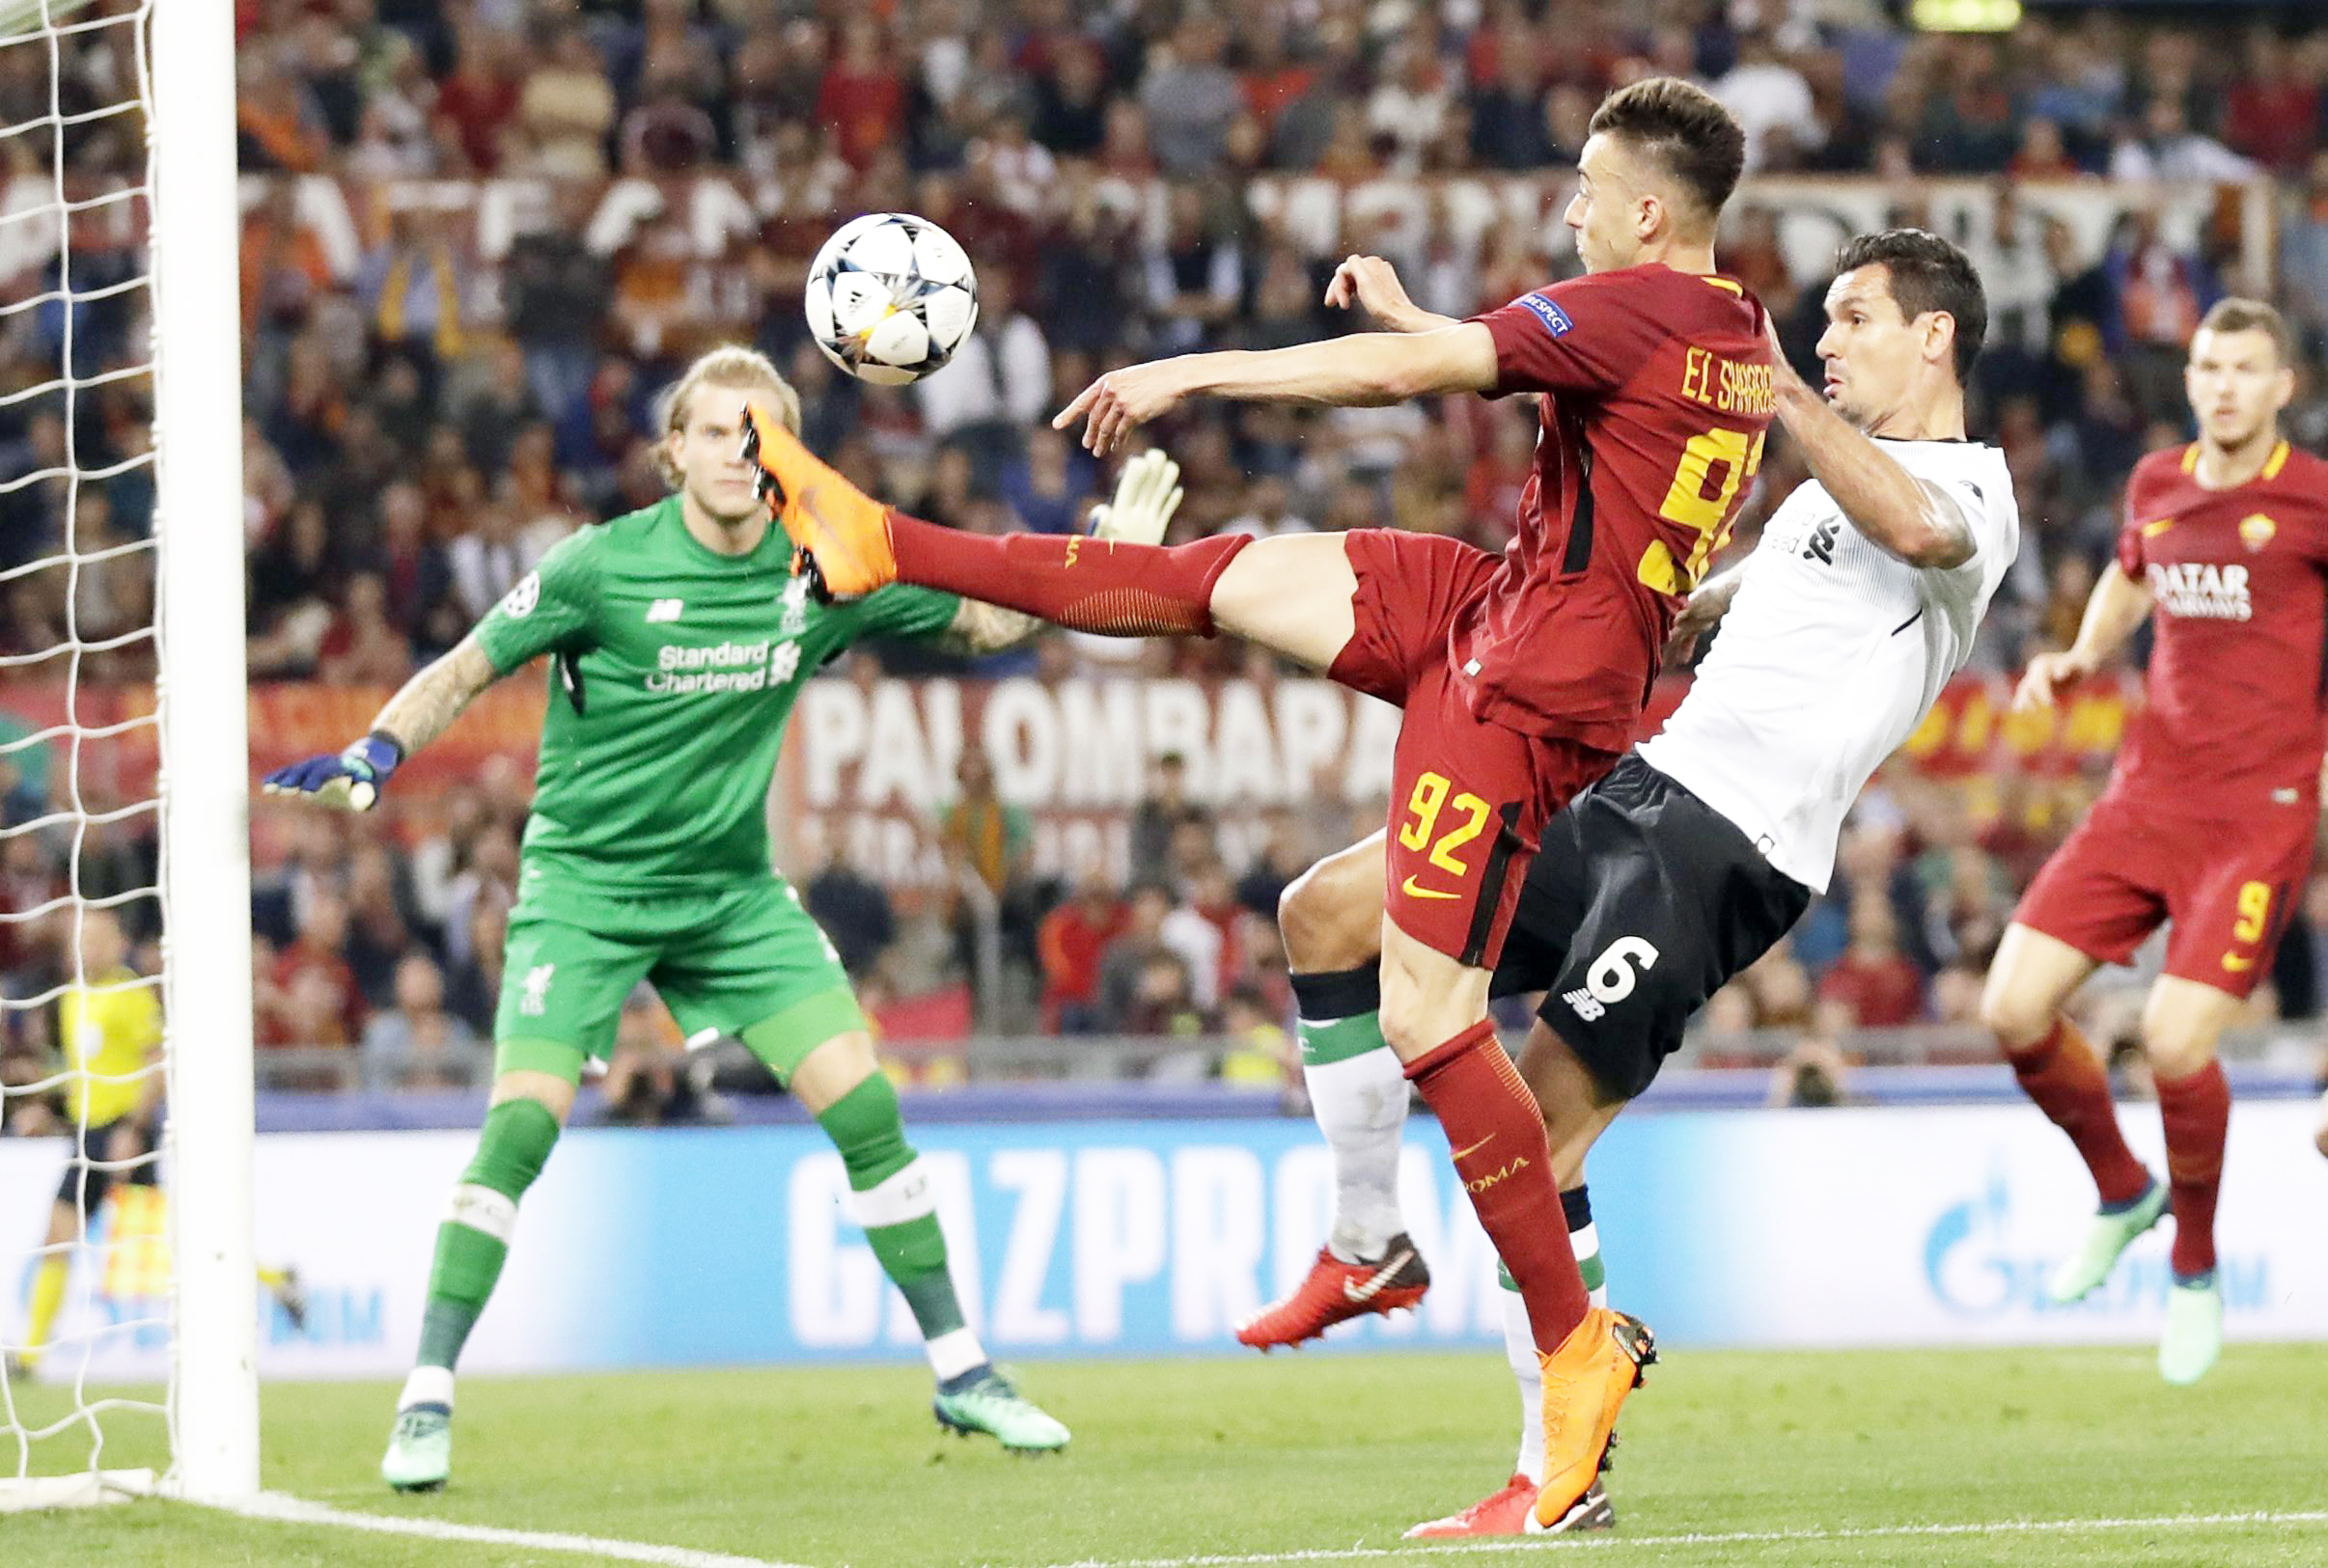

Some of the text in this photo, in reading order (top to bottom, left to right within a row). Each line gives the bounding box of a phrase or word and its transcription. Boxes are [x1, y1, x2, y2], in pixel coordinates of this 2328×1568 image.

[1681, 346, 1713, 404] EL
[645, 667, 766, 694] Chartered
[658, 641, 770, 672] Standard
[1399, 771, 1491, 877] 92
[2233, 879, 2272, 944] 9
[1586, 935, 1660, 1004] 6
